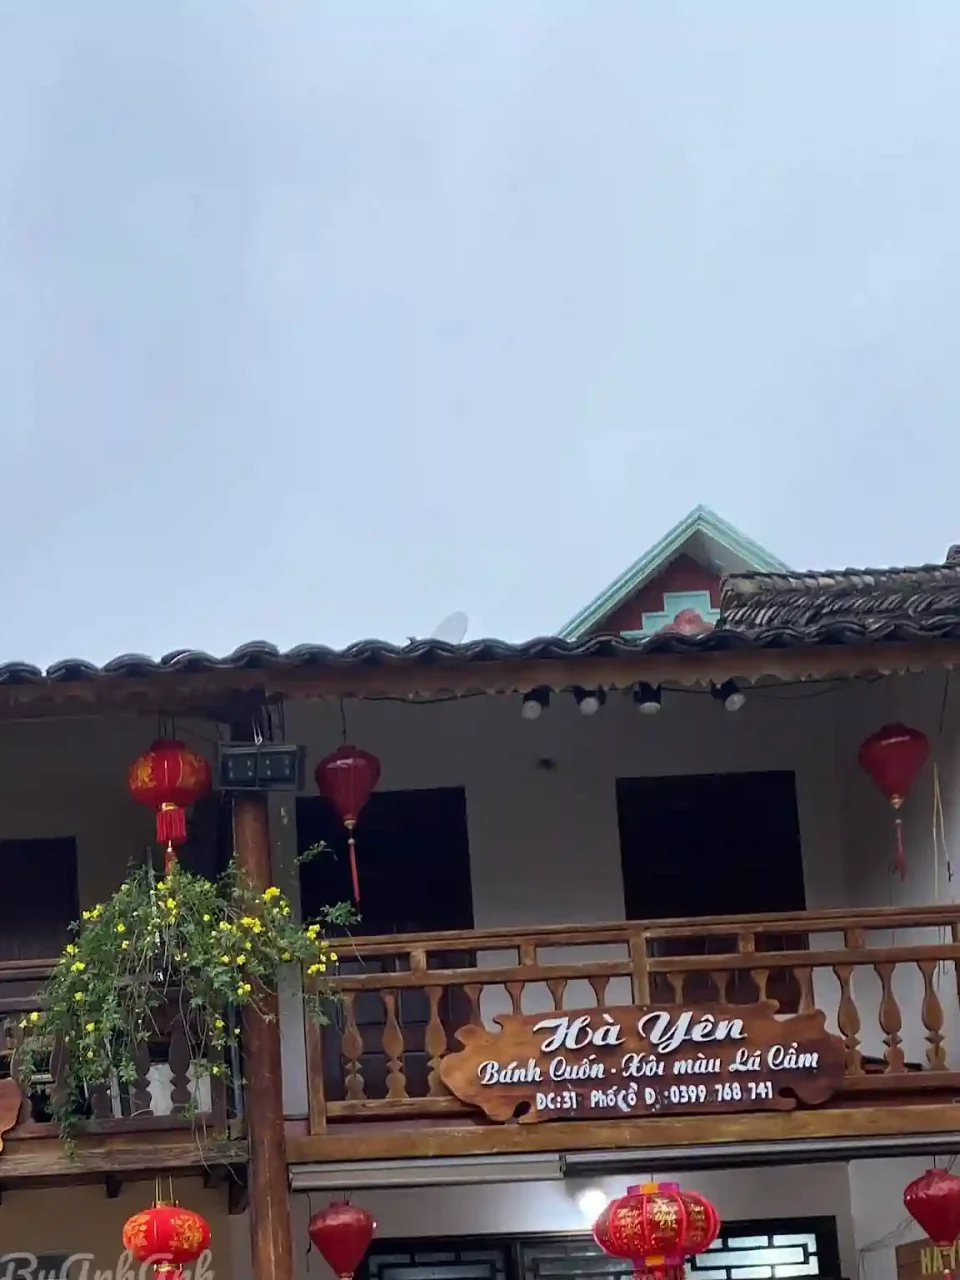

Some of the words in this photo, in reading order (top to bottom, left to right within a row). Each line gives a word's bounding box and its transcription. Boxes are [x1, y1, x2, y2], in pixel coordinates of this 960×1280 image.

[533, 1014, 626, 1052] Hà
[638, 1011, 747, 1053] Yên
[478, 1058, 543, 1084] Bánh
[550, 1054, 606, 1081] Cuốn
[673, 1052, 721, 1075] màu
[715, 1082, 741, 1101] 768
[748, 1081, 773, 1099] 741
